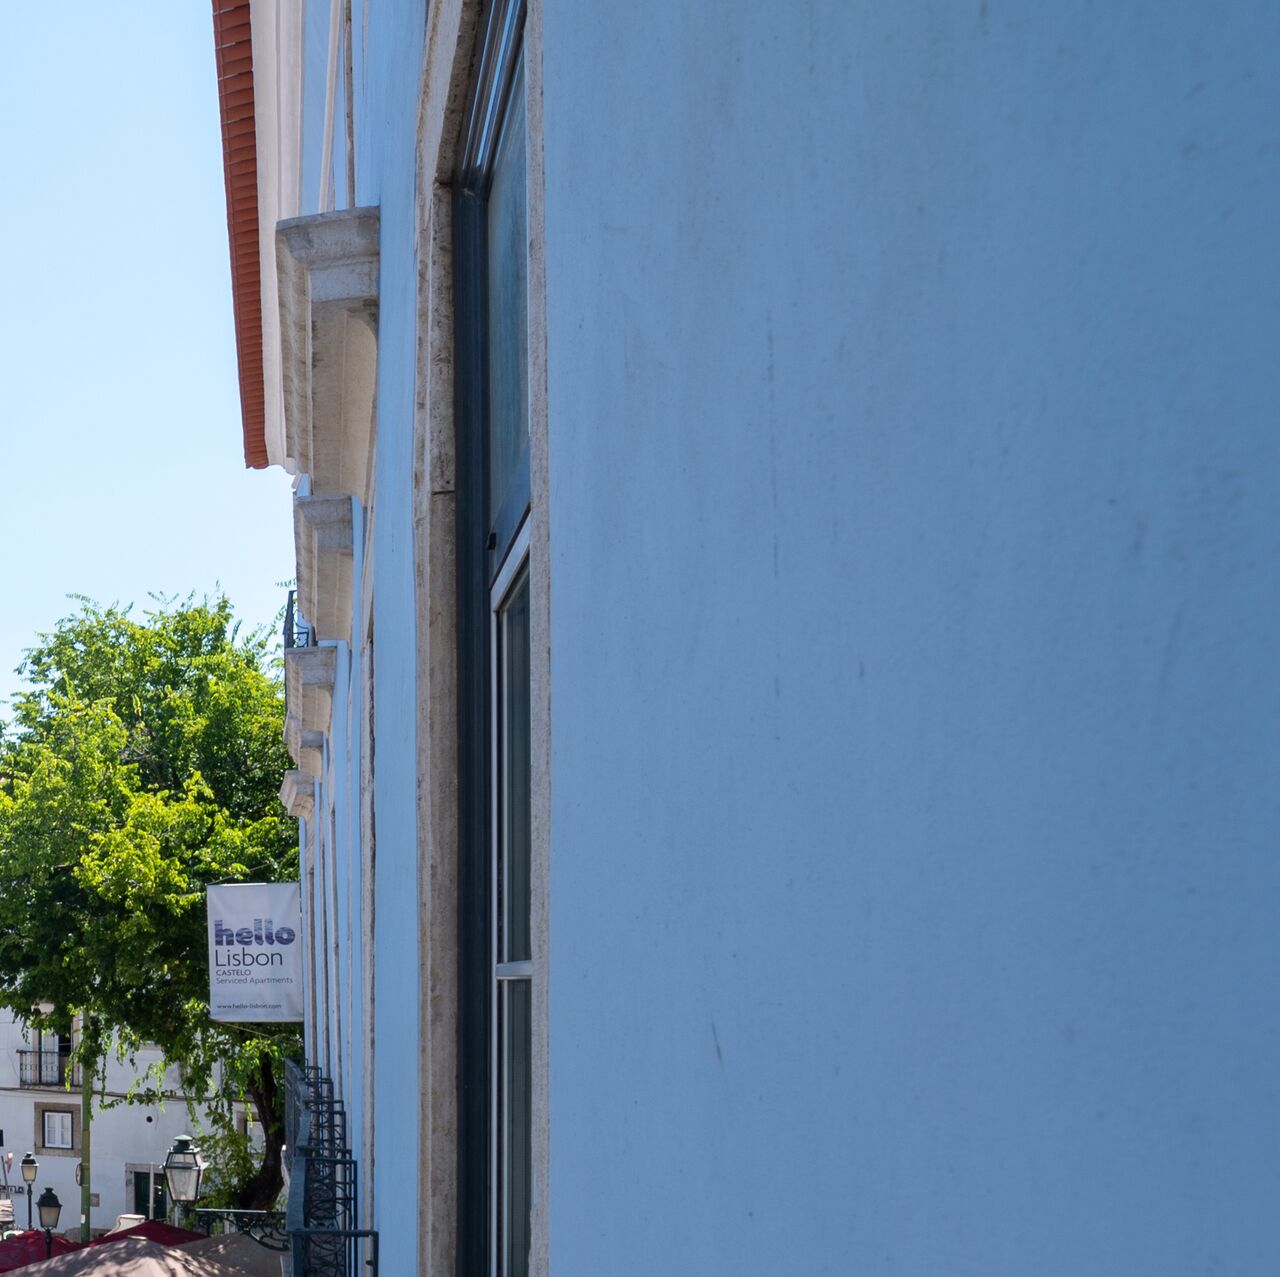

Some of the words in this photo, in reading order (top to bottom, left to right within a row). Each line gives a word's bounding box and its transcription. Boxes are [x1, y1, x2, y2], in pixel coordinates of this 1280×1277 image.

[214, 918, 296, 946] hello
[215, 947, 283, 967] Lisbon
[215, 968, 251, 977] CASTELO
[216, 977, 248, 985] Serviced
[249, 976, 293, 985] Apartments
